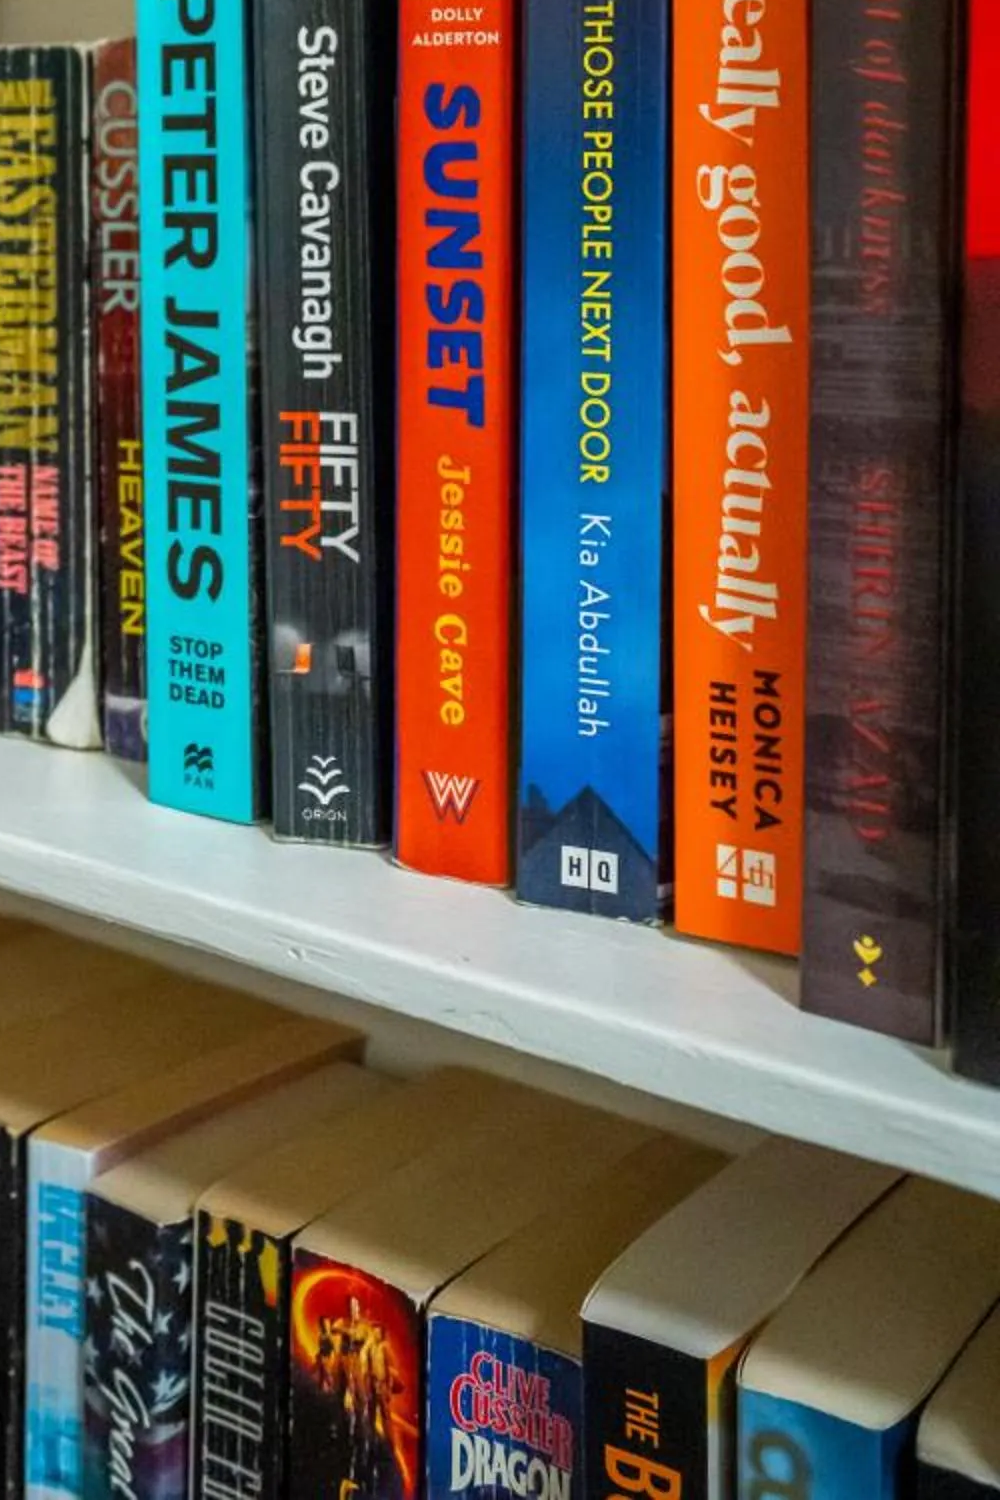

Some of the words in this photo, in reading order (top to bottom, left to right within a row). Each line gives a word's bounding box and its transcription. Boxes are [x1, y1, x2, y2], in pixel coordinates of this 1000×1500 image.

[411, 30, 500, 47] ALDERTON
[430, 6, 484, 23] DOLLY
[582, 0, 615, 120] THOSE
[849, 38, 908, 85] of
[298, 25, 339, 150] Steve
[99, 80, 140, 314] CUSSLER
[581, 130, 614, 259] PEOPLE
[291, 160, 344, 380] Cavanagh
[422, 81, 486, 430] SUNSET
[695, 162, 793, 367] good,
[579, 270, 613, 363] NEXT
[164, 296, 224, 603] JAMES
[278, 411, 323, 562] FIFTY
[318, 411, 360, 565] FIFTY
[579, 372, 612, 485] DOOR
[117, 439, 145, 636] HEAVEN
[437, 454, 471, 599] Jessie
[578, 513, 612, 568] Kia
[697, 389, 780, 653] actually
[168, 658, 226, 686] THEM
[169, 635, 223, 660] STOP
[169, 682, 226, 711] DEAD
[434, 613, 468, 726] Cave
[577, 579, 612, 738] Abdullah
[708, 680, 739, 821] HEISEY
[753, 669, 785, 832] MONICA
[300, 807, 348, 823] ORION
[105, 1258, 155, 1357] The
[204, 1300, 266, 1442] COLIN
[449, 1372, 574, 1471] CUSSLER
[469, 1350, 551, 1412] CLIVE
[624, 1386, 660, 1450] THE
[450, 1427, 572, 1500] DRAGON
